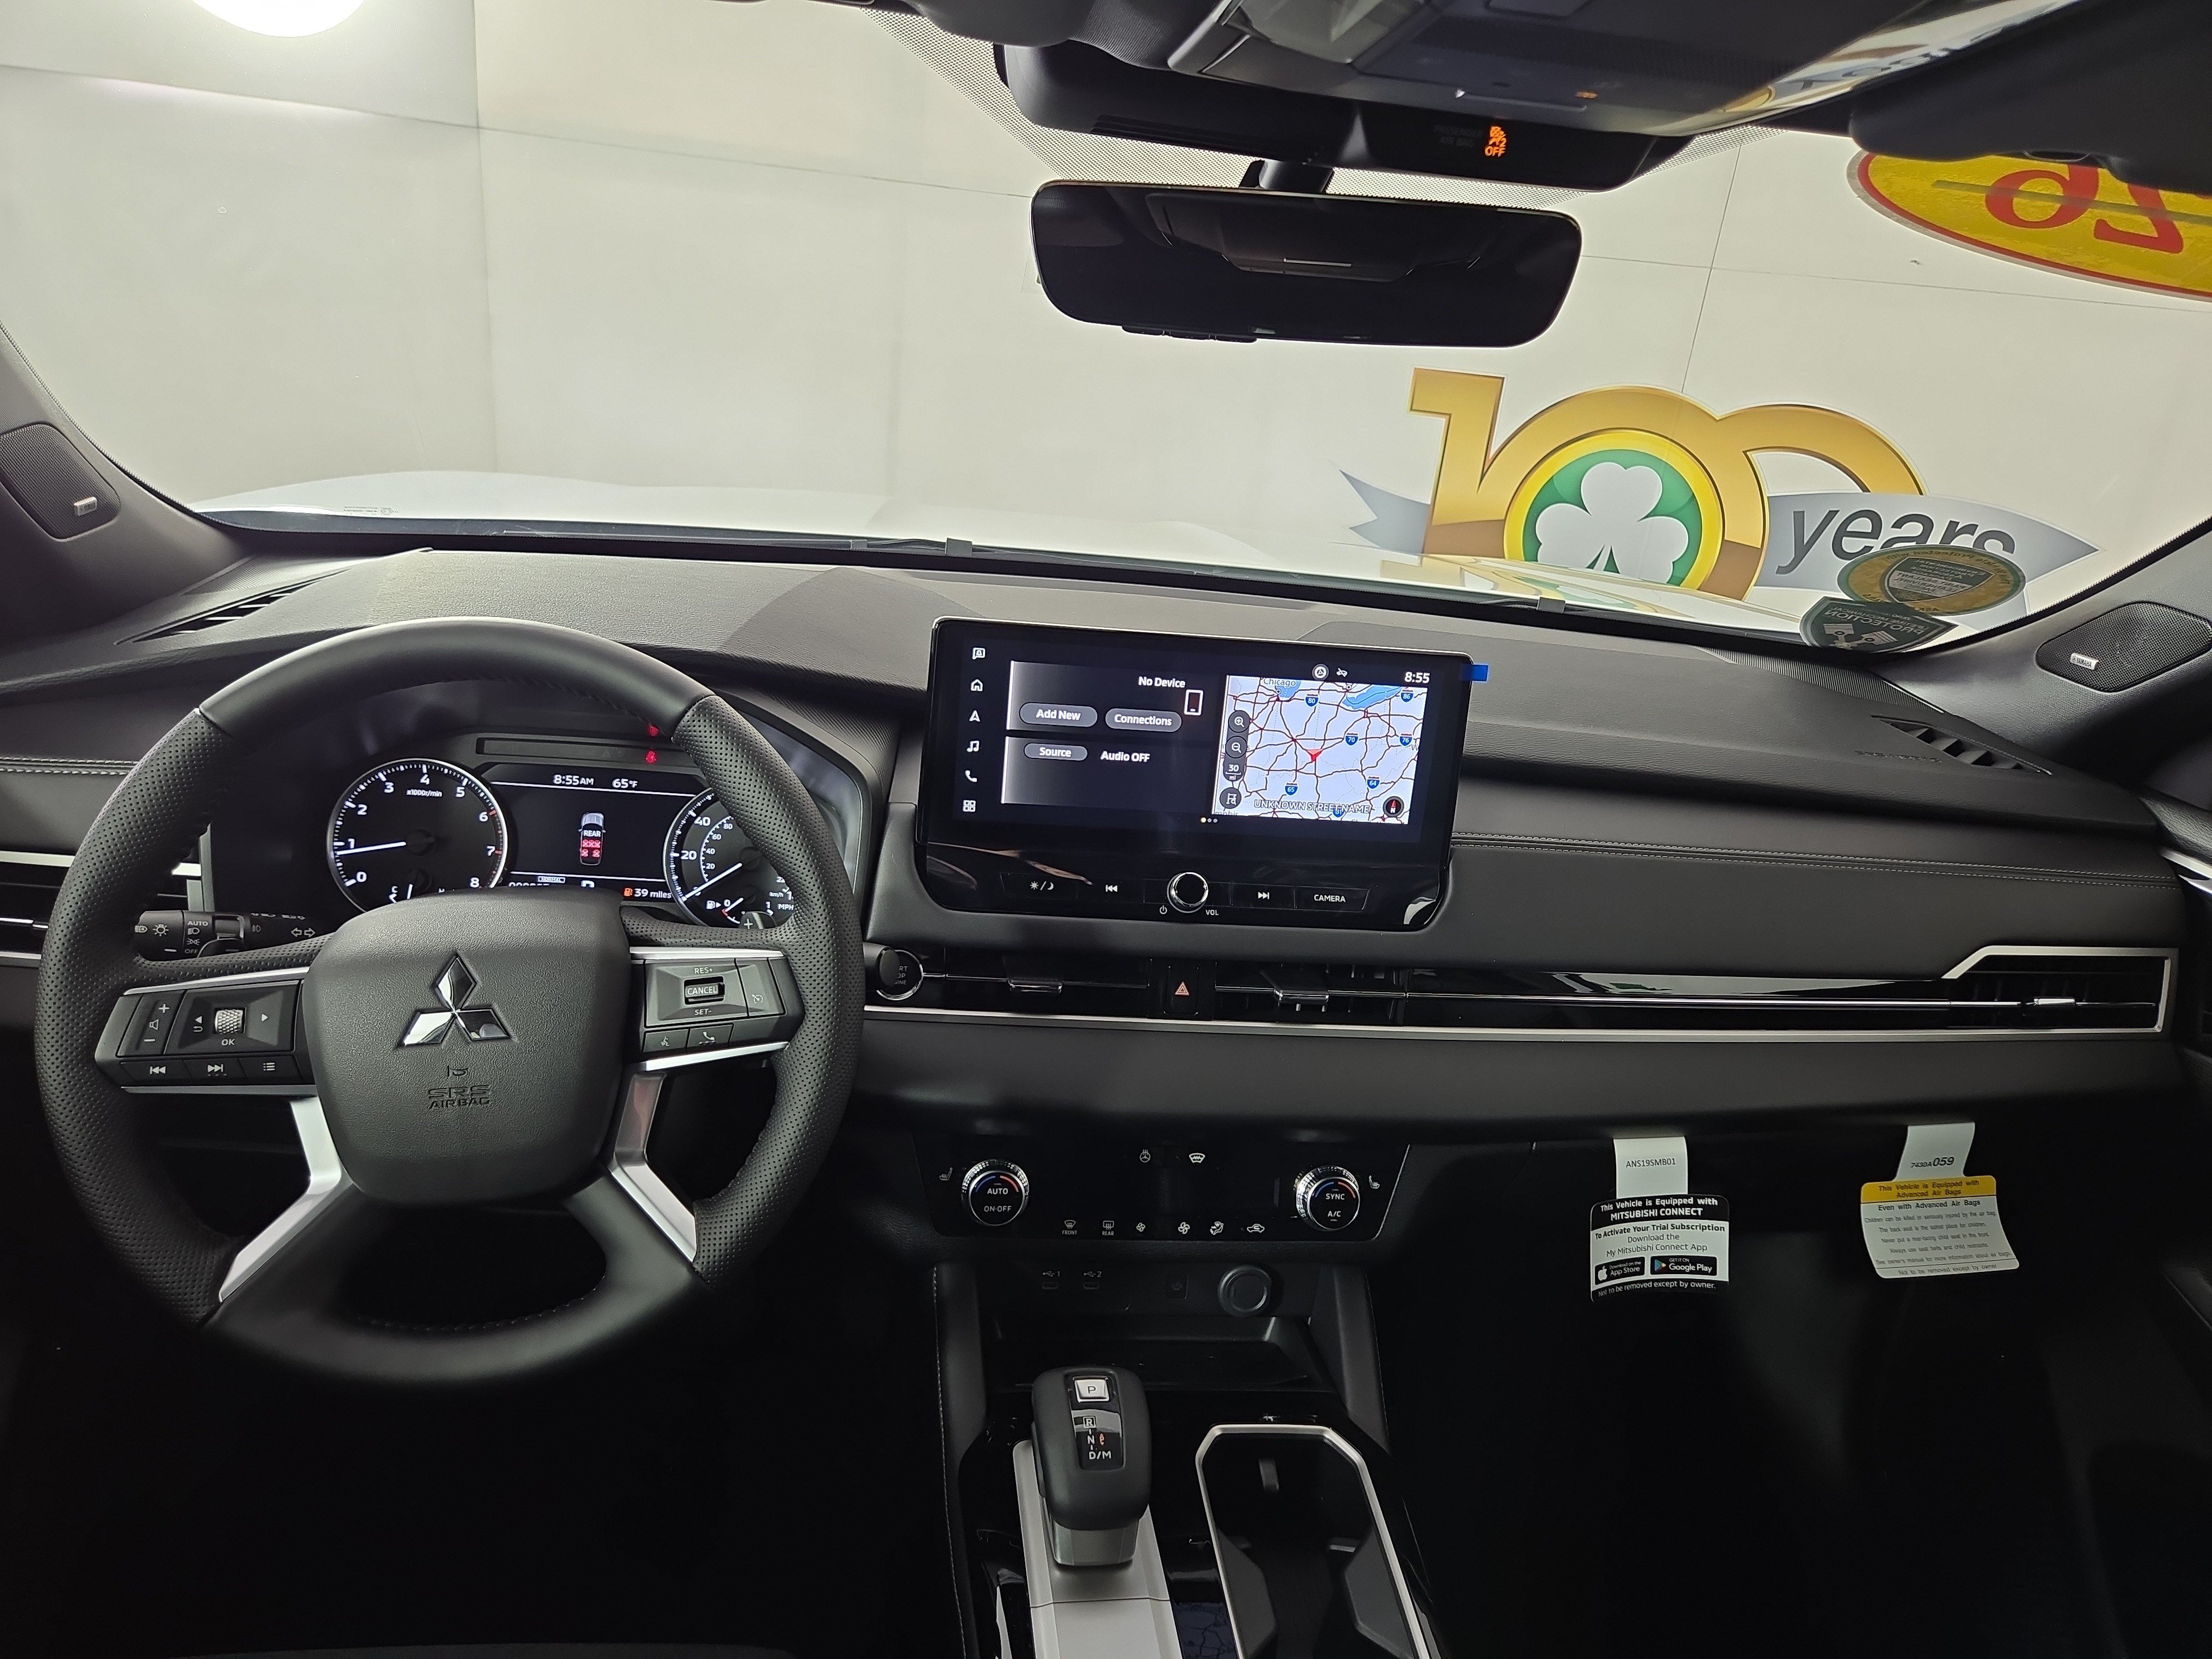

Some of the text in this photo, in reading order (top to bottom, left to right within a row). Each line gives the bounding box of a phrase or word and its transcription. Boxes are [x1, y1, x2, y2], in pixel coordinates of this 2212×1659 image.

[1485, 146, 1506, 157] OFF
[2076, 657, 2092, 668] YAMAHA
[1138, 676, 1186, 688] No Device
[1263, 678, 1296, 688] Chicago
[1404, 672, 1430, 684] 8:55
[1036, 709, 1081, 721] Add New
[1114, 714, 1172, 726] Connections
[1039, 747, 1072, 757] Source
[1101, 751, 1150, 763] Audio OFF
[1228, 764, 1239, 772] 30
[420, 774, 430, 785] 4
[612, 777, 638, 788] 65°F
[384, 782, 394, 793] 3
[455, 787, 465, 798] 5
[407, 789, 442, 797] x1000r/min
[358, 805, 368, 815] 2
[1254, 799, 1306, 811] UNKNOWN
[1307, 802, 1341, 813] STREET
[1341, 805, 1371, 814] NAME
[479, 812, 488, 822] 6
[694, 816, 711, 826] 40
[583, 829, 601, 838] REAR
[348, 839, 355, 849] 1
[487, 846, 496, 856] 7
[680, 850, 697, 860] 20
[356, 871, 366, 883] 0
[470, 877, 480, 888] 8
[634, 889, 672, 899] 39 miles
[1314, 894, 1346, 903] CAMERA
[724, 899, 731, 907] 0
[687, 985, 718, 995] CANCEL
[428, 1084, 490, 1099] SRS
[426, 1097, 490, 1110] AIRBAG
[1626, 1158, 1676, 1168] ANS19SMB01
[1896, 1190, 1928, 1198] Advanced
[1600, 1204, 1613, 1212] This
[1616, 1200, 1642, 1208] Vehicle
[1655, 1197, 1693, 1207] Equipped
[1697, 1197, 1718, 1206] with
[1915, 1200, 1947, 1209] Advanced
[1964, 1199, 1980, 1207] Bags
[1611, 1207, 1703, 1221] MITSUBISHI CONNECT
[1603, 1227, 1631, 1238] Activate
[1632, 1225, 1650, 1233] Your
[1670, 1223, 1725, 1233] Subscription
[1628, 1234, 1664, 1243] Download
[1606, 1250, 1616, 1258] My
[1617, 1244, 1654, 1255] Mitsubishi
[1690, 1243, 1708, 1252] App
[1668, 1263, 1713, 1273] Google Play
[1624, 1281, 1652, 1290] removed
[1680, 1281, 1689, 1289] by
[1087, 1386, 1096, 1394] P
[1086, 1418, 1093, 1426] R
[1088, 1435, 1095, 1444] N
[1089, 1450, 1111, 1460] D/M
